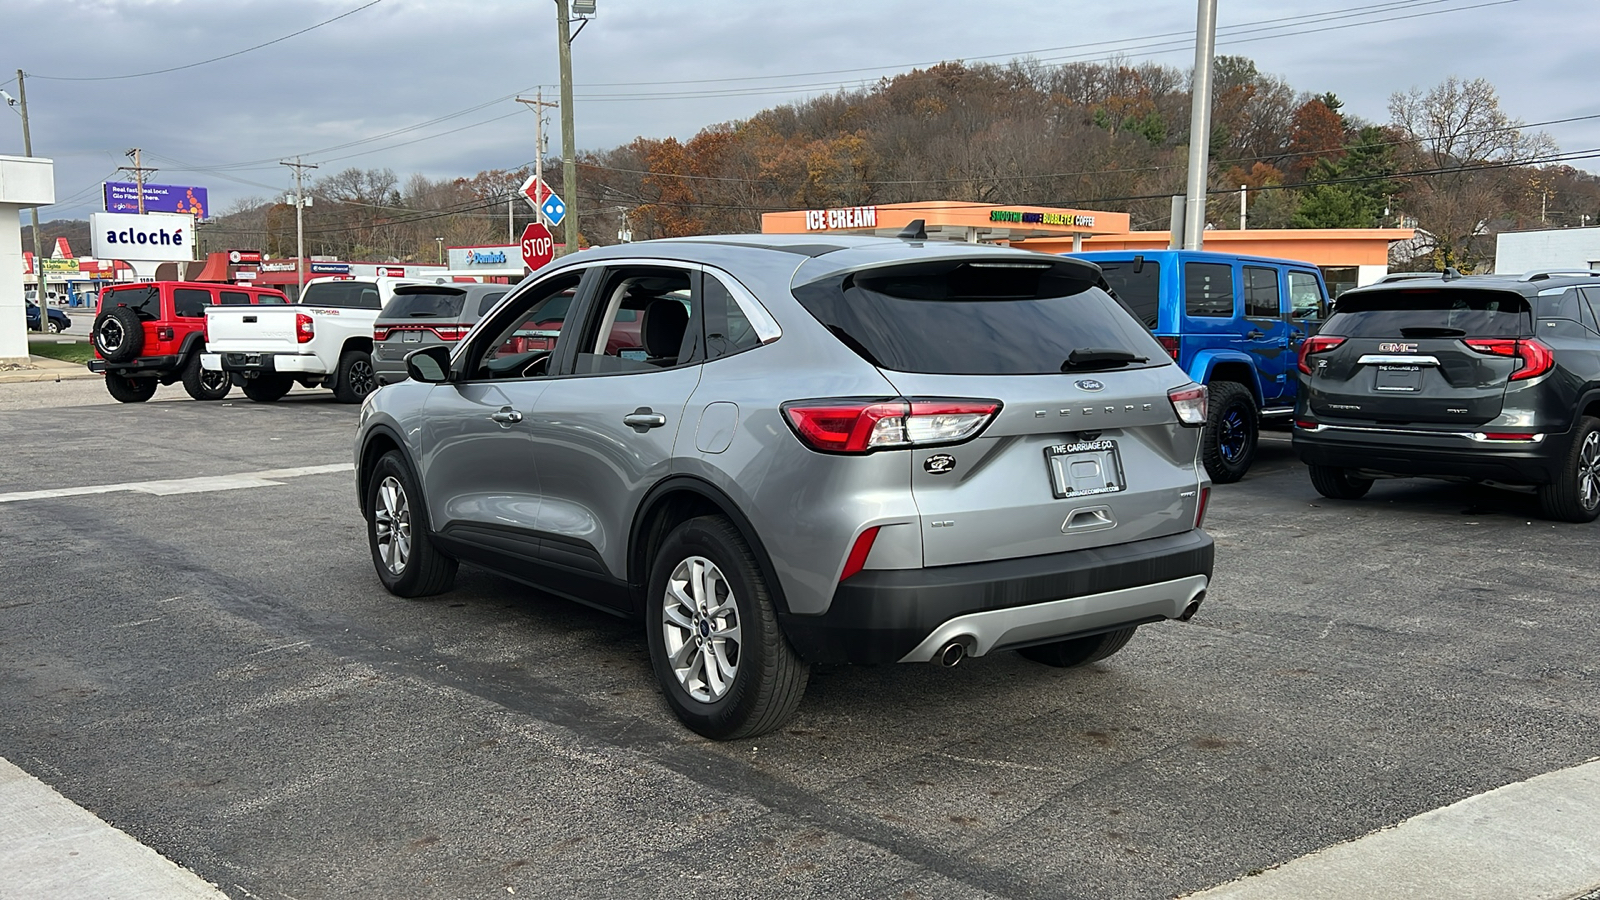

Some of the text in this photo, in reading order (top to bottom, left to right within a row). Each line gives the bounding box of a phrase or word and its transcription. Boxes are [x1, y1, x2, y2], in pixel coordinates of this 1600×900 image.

[805, 206, 877, 230] ICE CREAM
[1075, 215, 1095, 227] COFFEE
[106, 227, 183, 246] acloché
[523, 237, 551, 258] STOP
[475, 251, 507, 264] Domino's
[1379, 342, 1419, 353] GMC
[1082, 380, 1100, 389] Ford
[1051, 440, 1114, 454] THE CARRIAGE CO.
[1065, 485, 1120, 498] CARRIAGECOMPANY.COM
